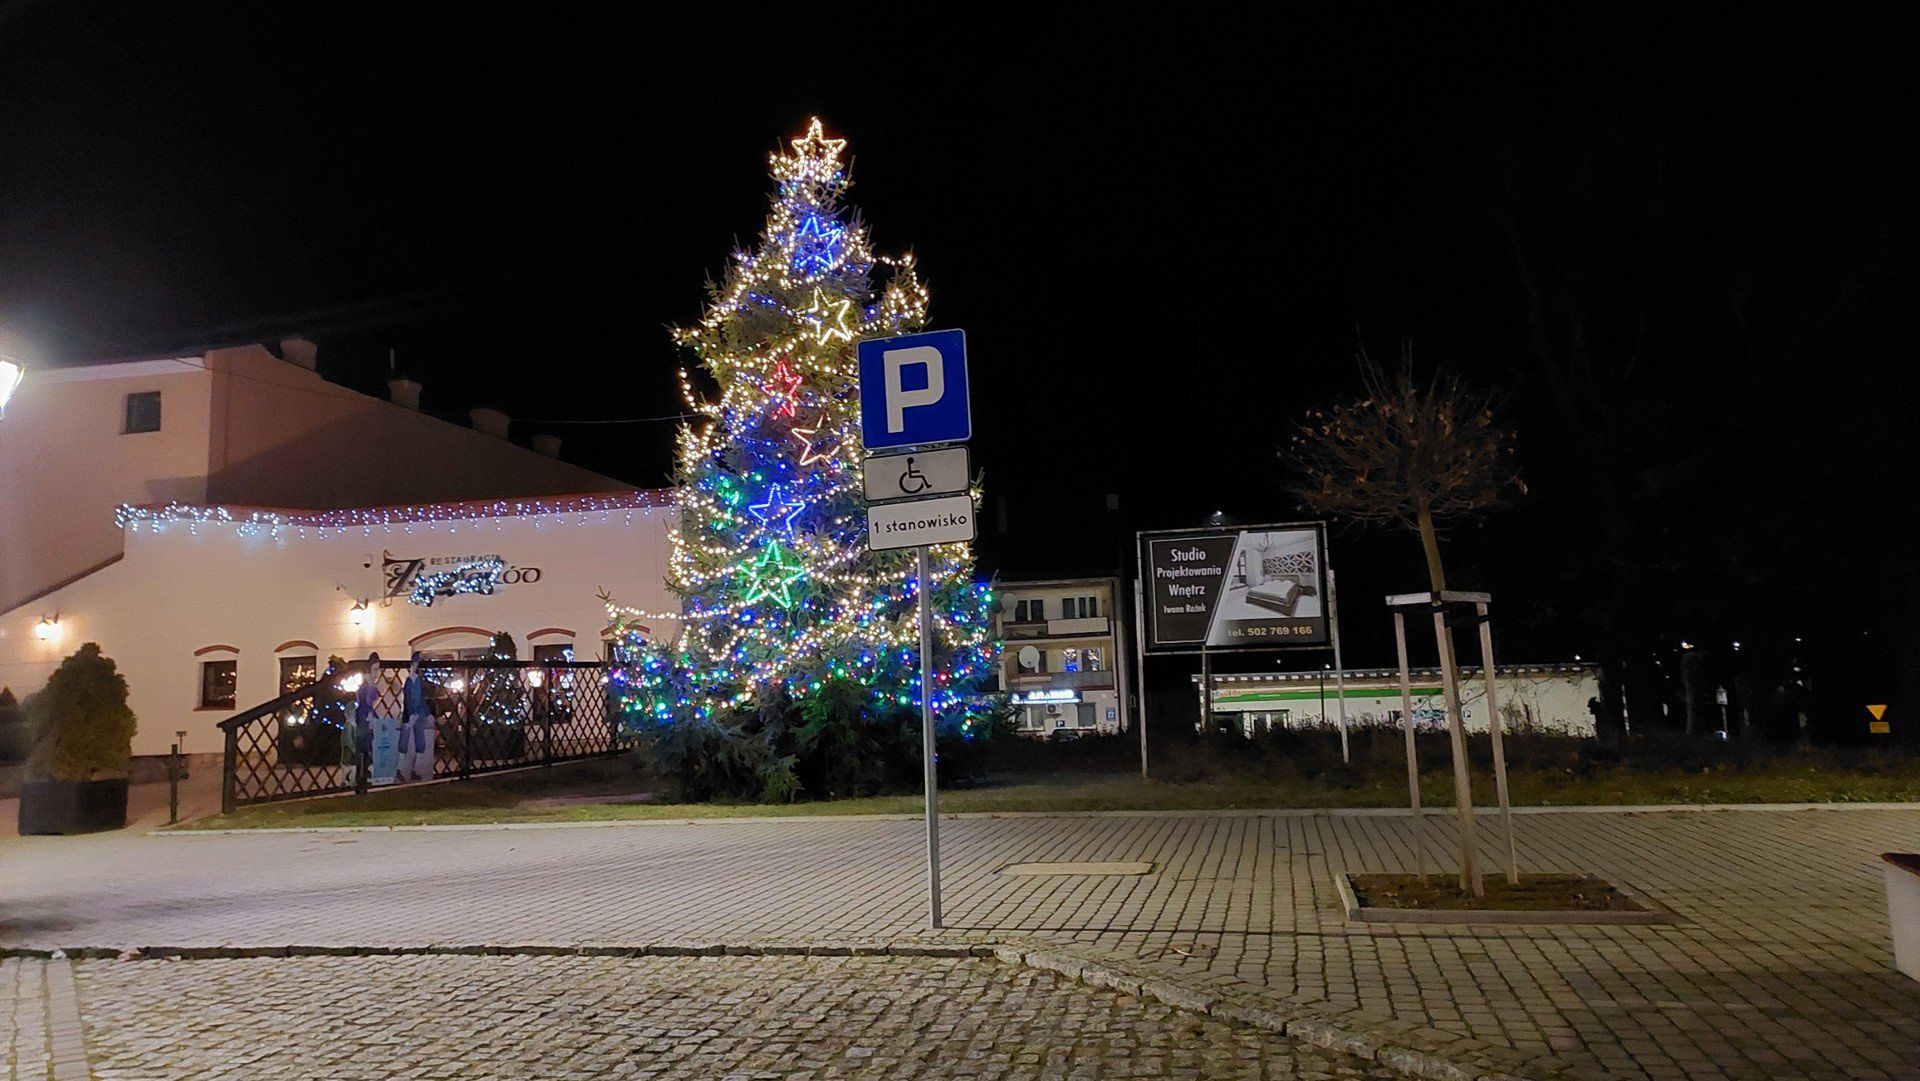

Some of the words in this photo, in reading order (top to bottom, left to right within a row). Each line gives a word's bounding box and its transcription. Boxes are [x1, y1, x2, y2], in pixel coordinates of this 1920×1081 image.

[883, 346, 944, 433] P
[874, 521, 880, 533] 1
[886, 513, 967, 533] stanowisko
[1171, 547, 1206, 562] Studio
[1157, 565, 1222, 580] Projektowania
[1168, 584, 1206, 598] Wnętrz
[1247, 627, 1267, 636] 502
[1269, 626, 1290, 635] 769
[1292, 626, 1313, 635] 166
